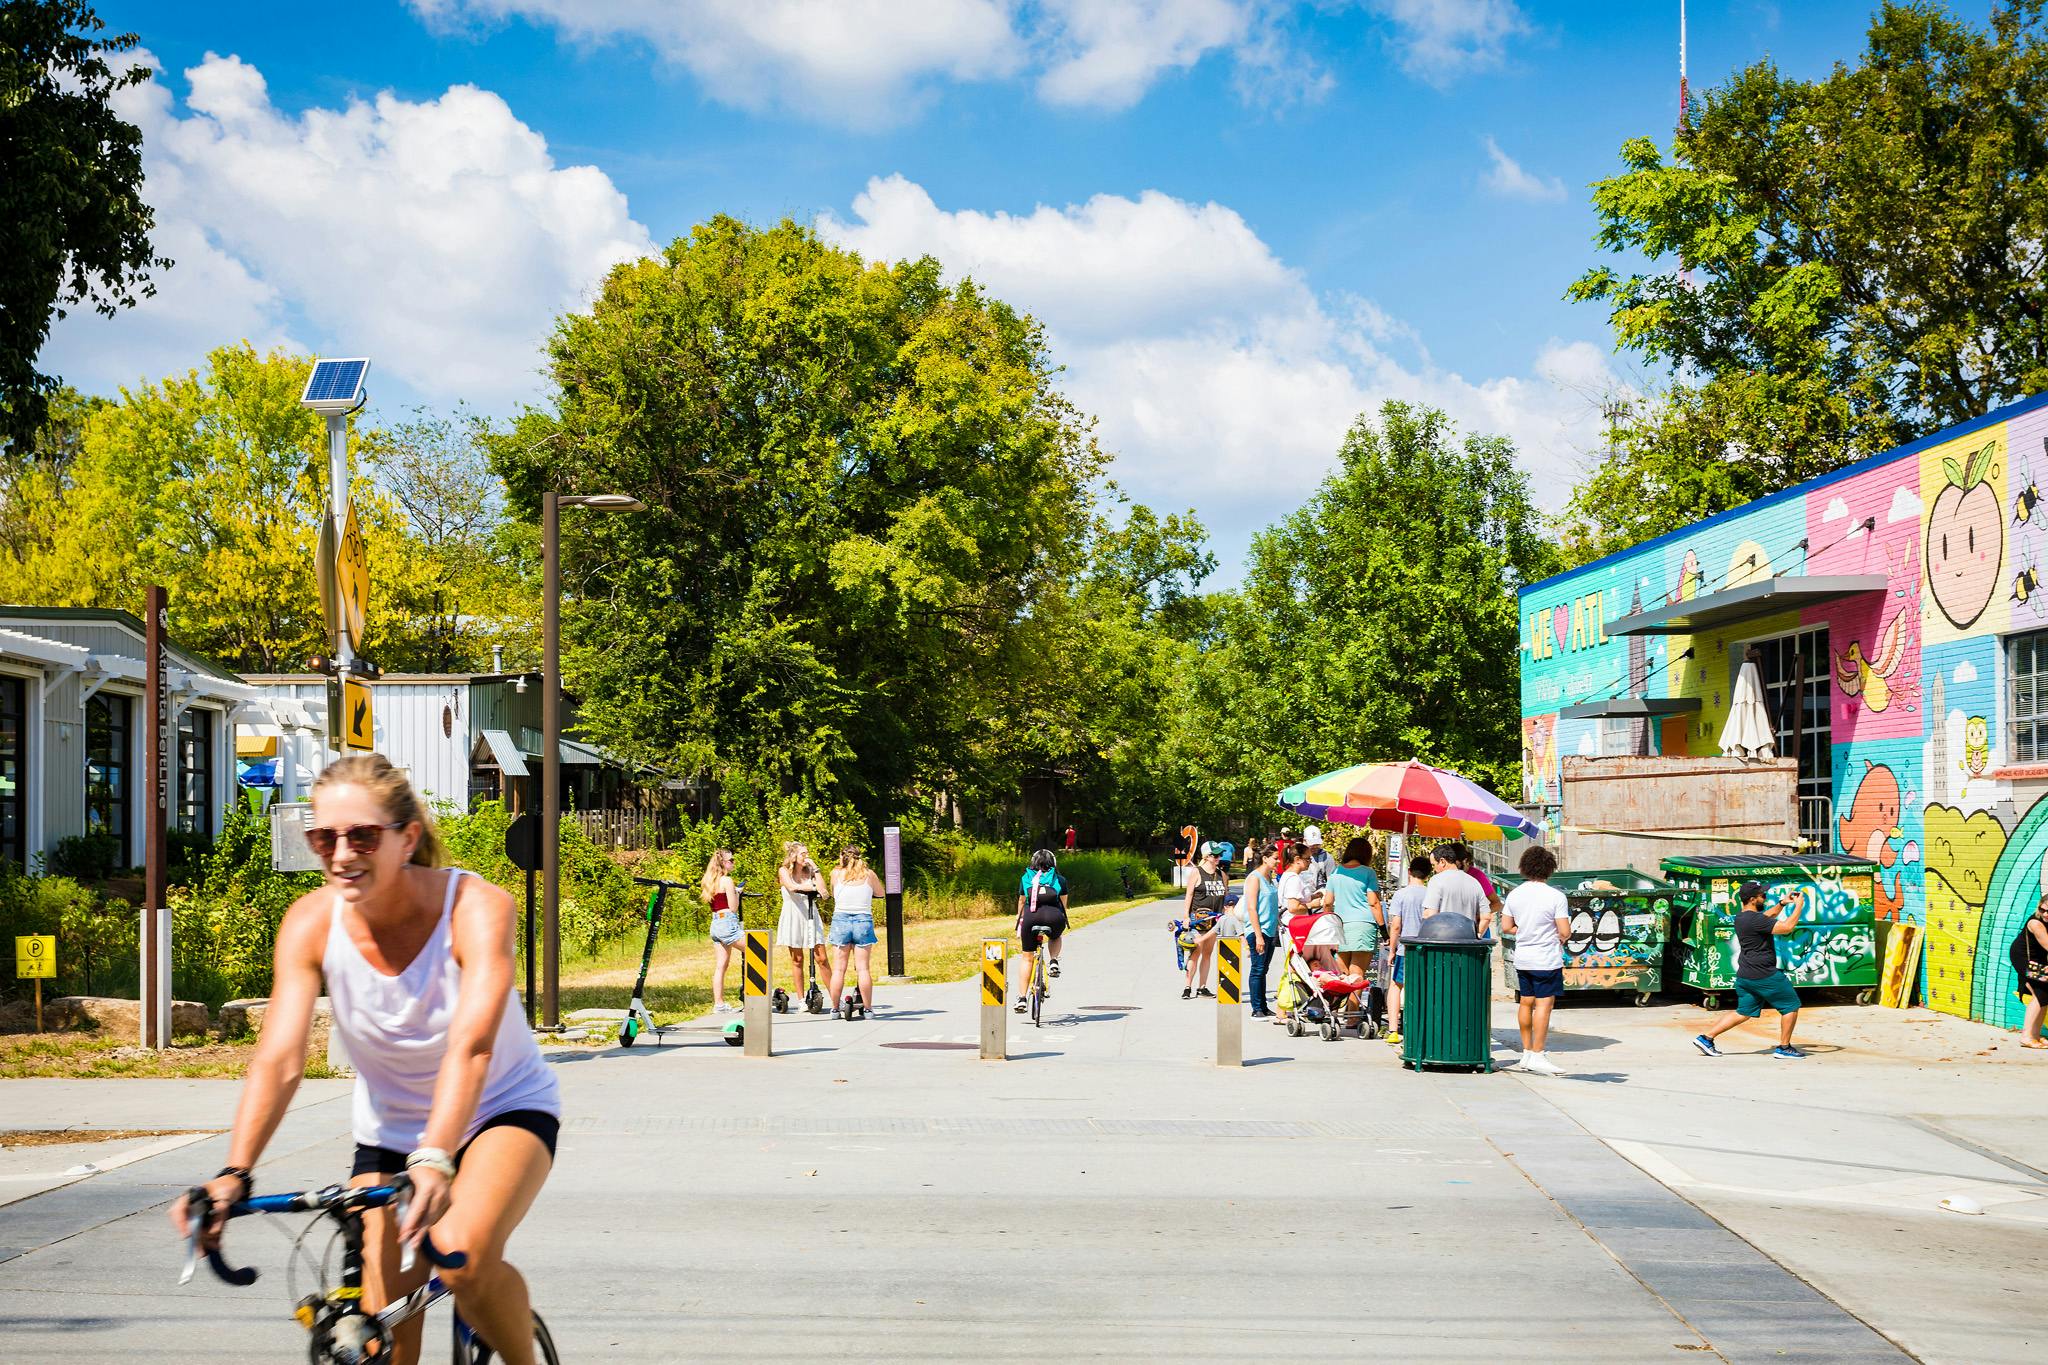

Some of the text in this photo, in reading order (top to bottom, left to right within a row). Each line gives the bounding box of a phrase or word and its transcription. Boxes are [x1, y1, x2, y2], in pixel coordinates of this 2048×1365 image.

[1529, 590, 1609, 663] WE ATL
[159, 642, 168, 809] Atlanta BeltLine
[32, 943, 40, 954] P
